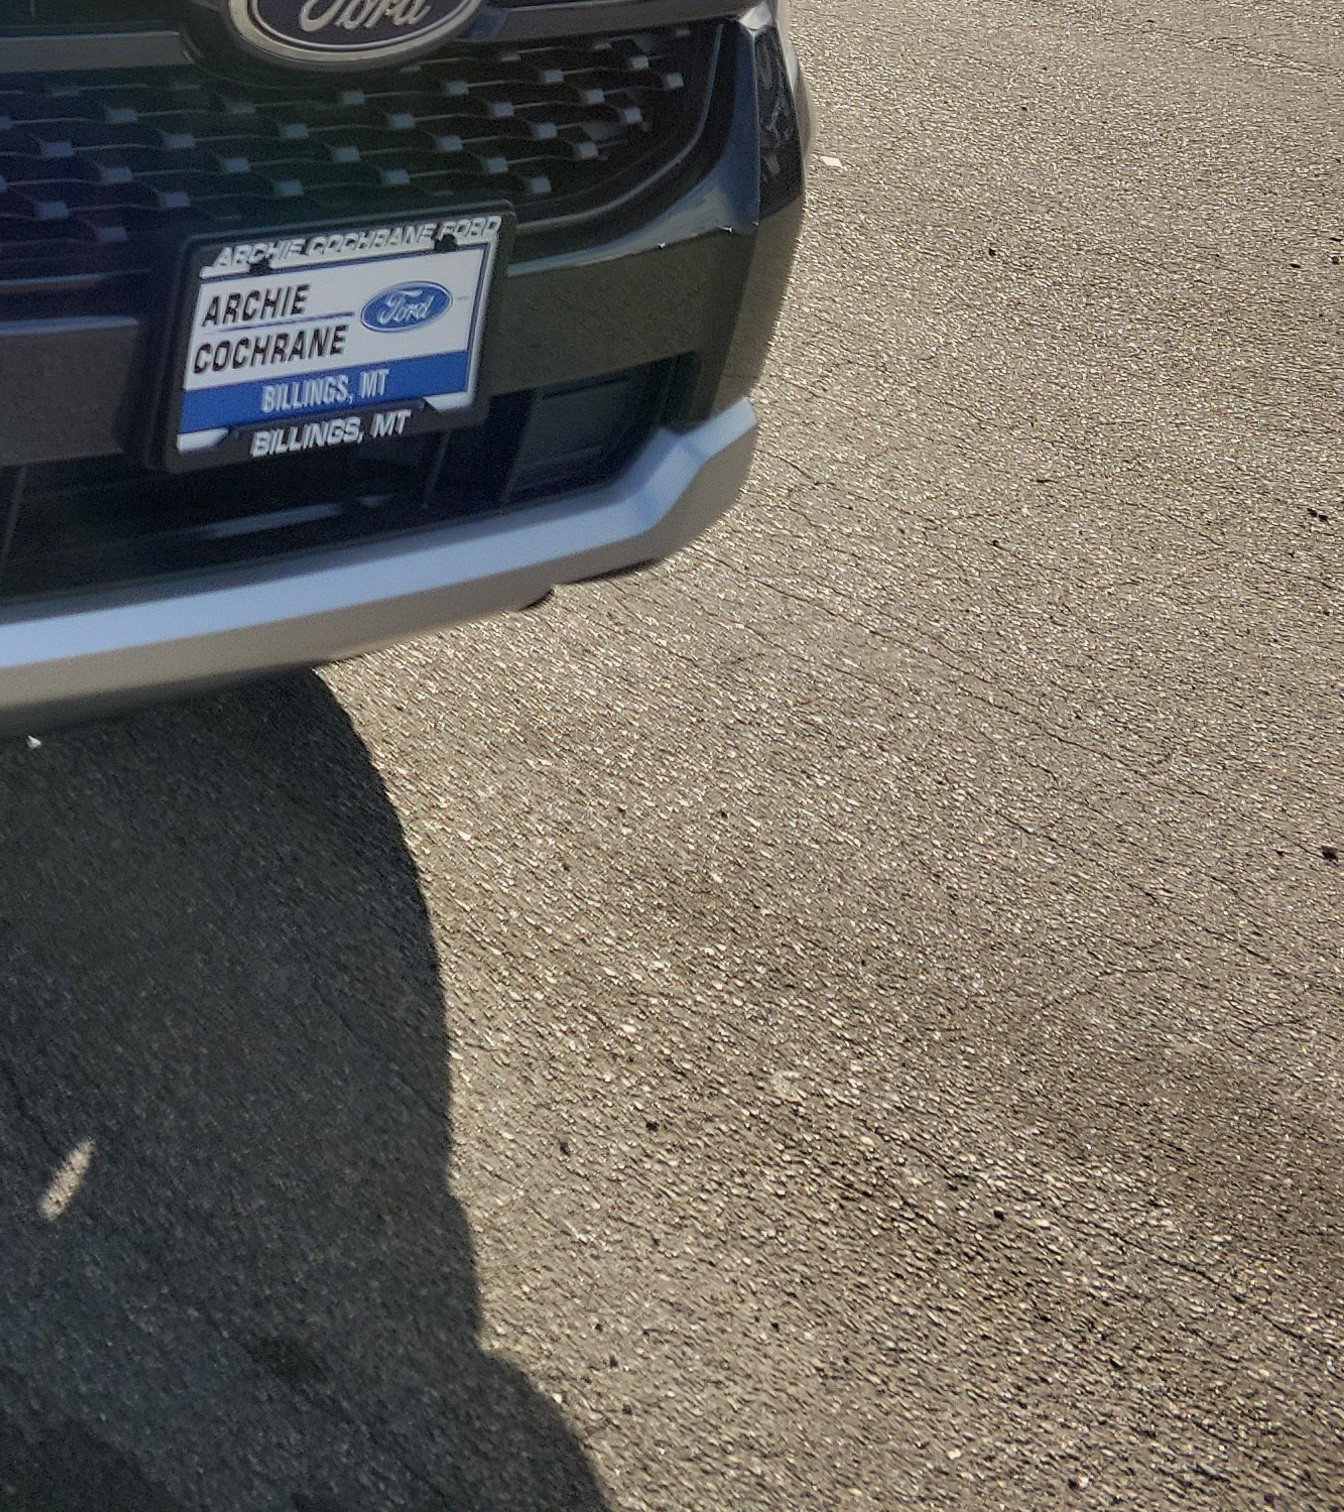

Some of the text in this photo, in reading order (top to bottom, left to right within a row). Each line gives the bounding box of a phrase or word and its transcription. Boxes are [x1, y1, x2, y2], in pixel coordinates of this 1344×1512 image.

[307, 223, 437, 258] COCHRANE
[202, 284, 310, 328] ARCHIE
[377, 289, 435, 326] Ford
[193, 324, 349, 375] COCHRANE
[260, 369, 390, 414] BILLINGS, MT
[250, 409, 412, 458] BILLINGS, MT
